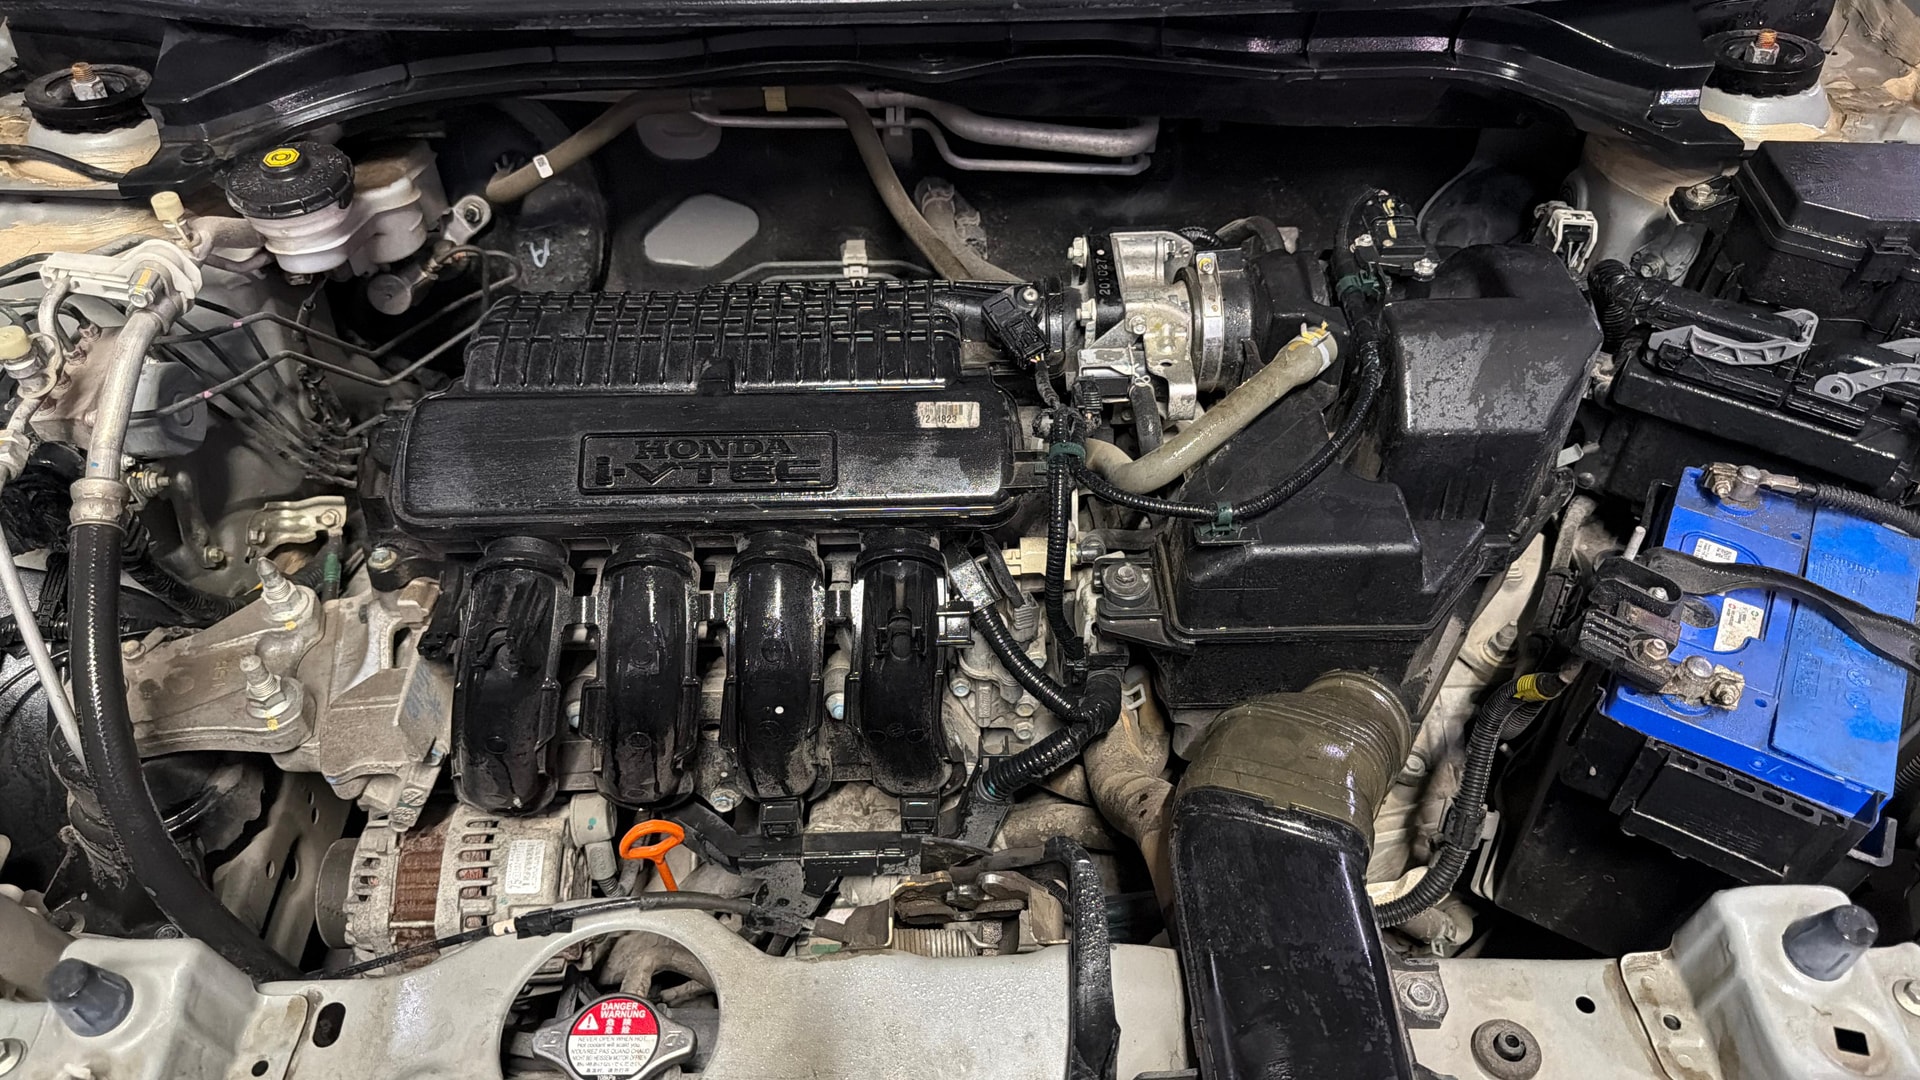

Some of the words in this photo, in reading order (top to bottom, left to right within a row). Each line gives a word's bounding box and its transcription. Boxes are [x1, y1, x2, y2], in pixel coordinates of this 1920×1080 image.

[634, 438, 797, 460] HONDA
[595, 455, 821, 486] i-VTEC
[601, 1002, 639, 1010] DANGER
[600, 1010, 646, 1018] WARNUNG
